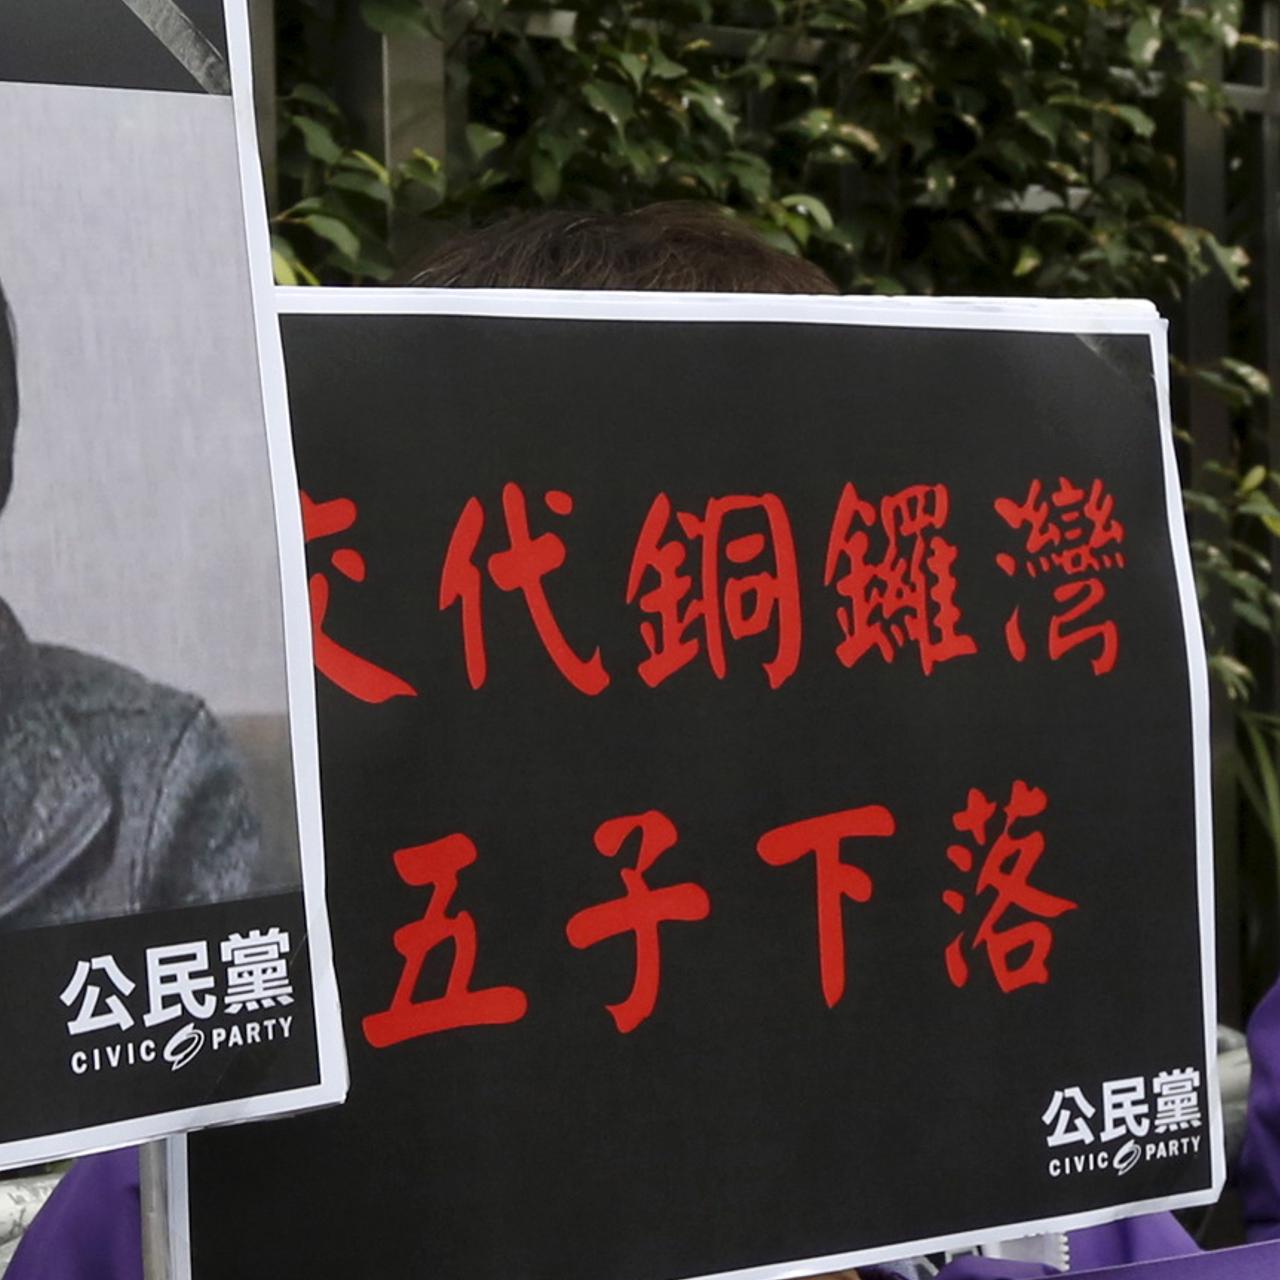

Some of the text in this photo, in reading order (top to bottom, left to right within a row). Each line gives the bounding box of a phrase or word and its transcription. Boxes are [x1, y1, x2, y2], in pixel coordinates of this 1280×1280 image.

[362, 779, 1078, 1048] 五子下落
[59, 927, 295, 1035] 公民黨
[71, 1016, 293, 1074] CIVIC PARTY
[1041, 1067, 1203, 1147] 公民黨
[1048, 1135, 1201, 1177] CIVIC PARTY
